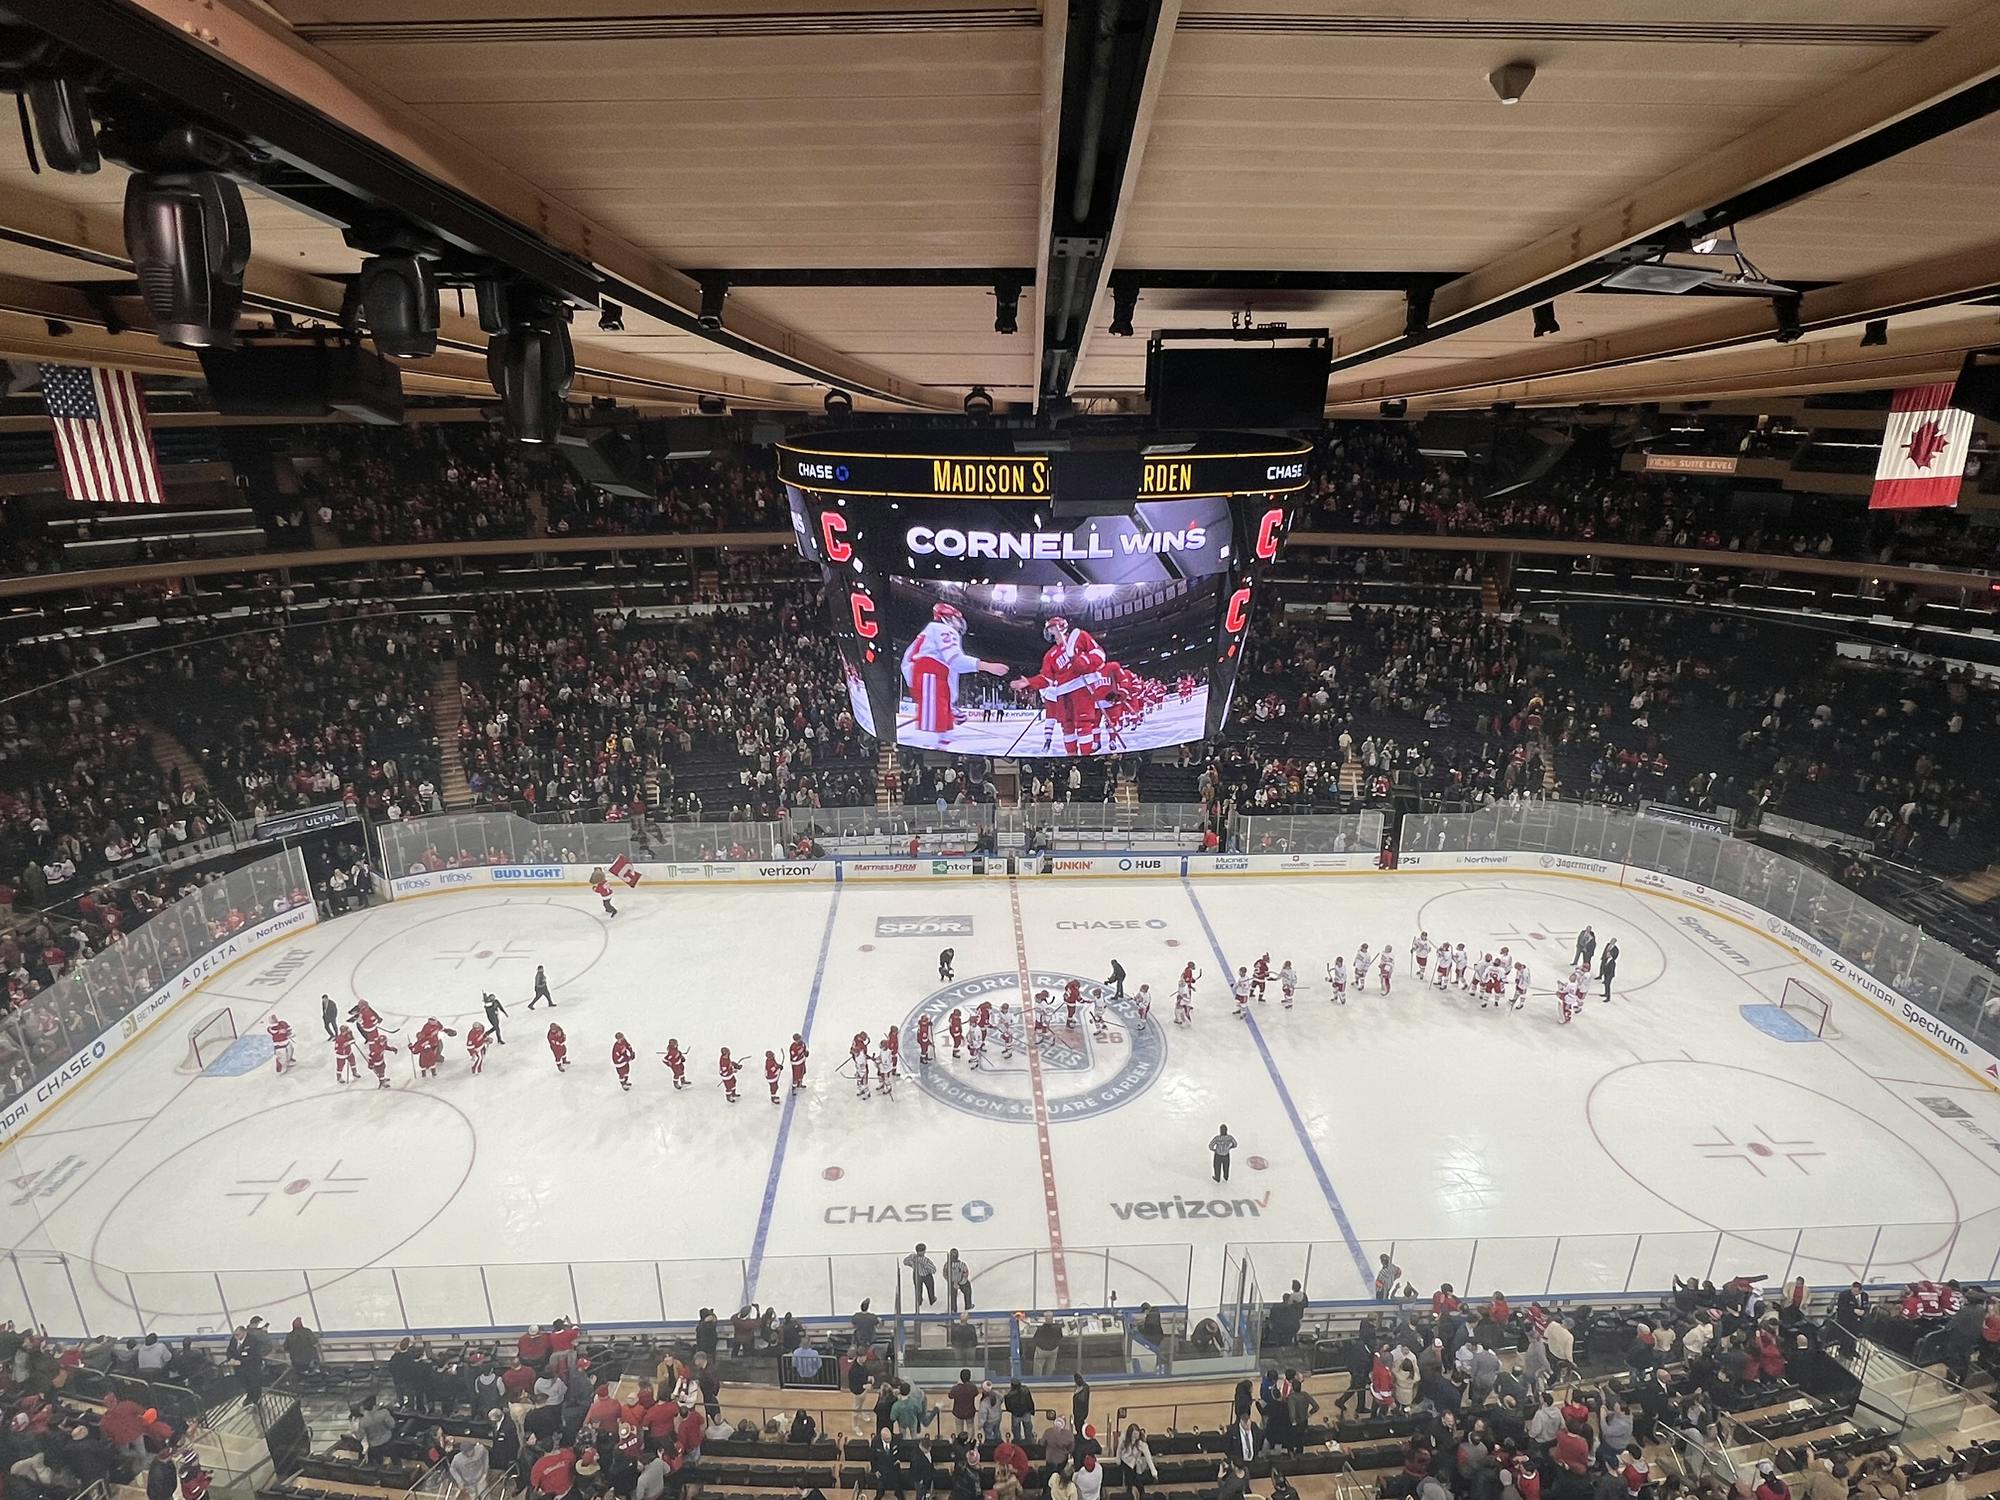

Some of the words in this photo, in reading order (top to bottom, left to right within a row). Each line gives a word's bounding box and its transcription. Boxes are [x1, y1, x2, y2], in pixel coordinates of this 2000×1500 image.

[798, 462, 833, 479] CHASE
[1267, 463, 1303, 480] CHASE
[1680, 460, 1704, 468] SUITE
[1706, 461, 1733, 470] LEVEL
[933, 460, 1025, 493] MADISON
[1139, 463, 1192, 492] RDEN
[906, 526, 1113, 560] CORNELL
[1120, 527, 1207, 555] WINS
[305, 814, 339, 827] ULTRA
[1689, 821, 1722, 833] ULTRA
[494, 869, 521, 879] BUD
[523, 868, 561, 878] LIGHT
[759, 865, 811, 877] verizon
[1135, 860, 1161, 869] HUB
[396, 878, 431, 891] Infosys
[440, 872, 473, 884] Infosys
[255, 911, 305, 939] Northwell
[1056, 920, 1141, 930] CHASE
[1677, 915, 1750, 967] Spectrum
[192, 944, 237, 979] DELTA
[948, 976, 1016, 999] YORK
[1848, 970, 1896, 1007] HYUNDAI
[1095, 1031, 1124, 1044] 26
[1902, 1003, 1966, 1054] Spectrum
[36, 1052, 92, 1103] CHASE
[928, 1072, 1002, 1112] MADISON
[1101, 1061, 1150, 1101] GARDEN
[824, 1203, 953, 1224] CHASE
[1110, 1195, 1261, 1220] verizon
